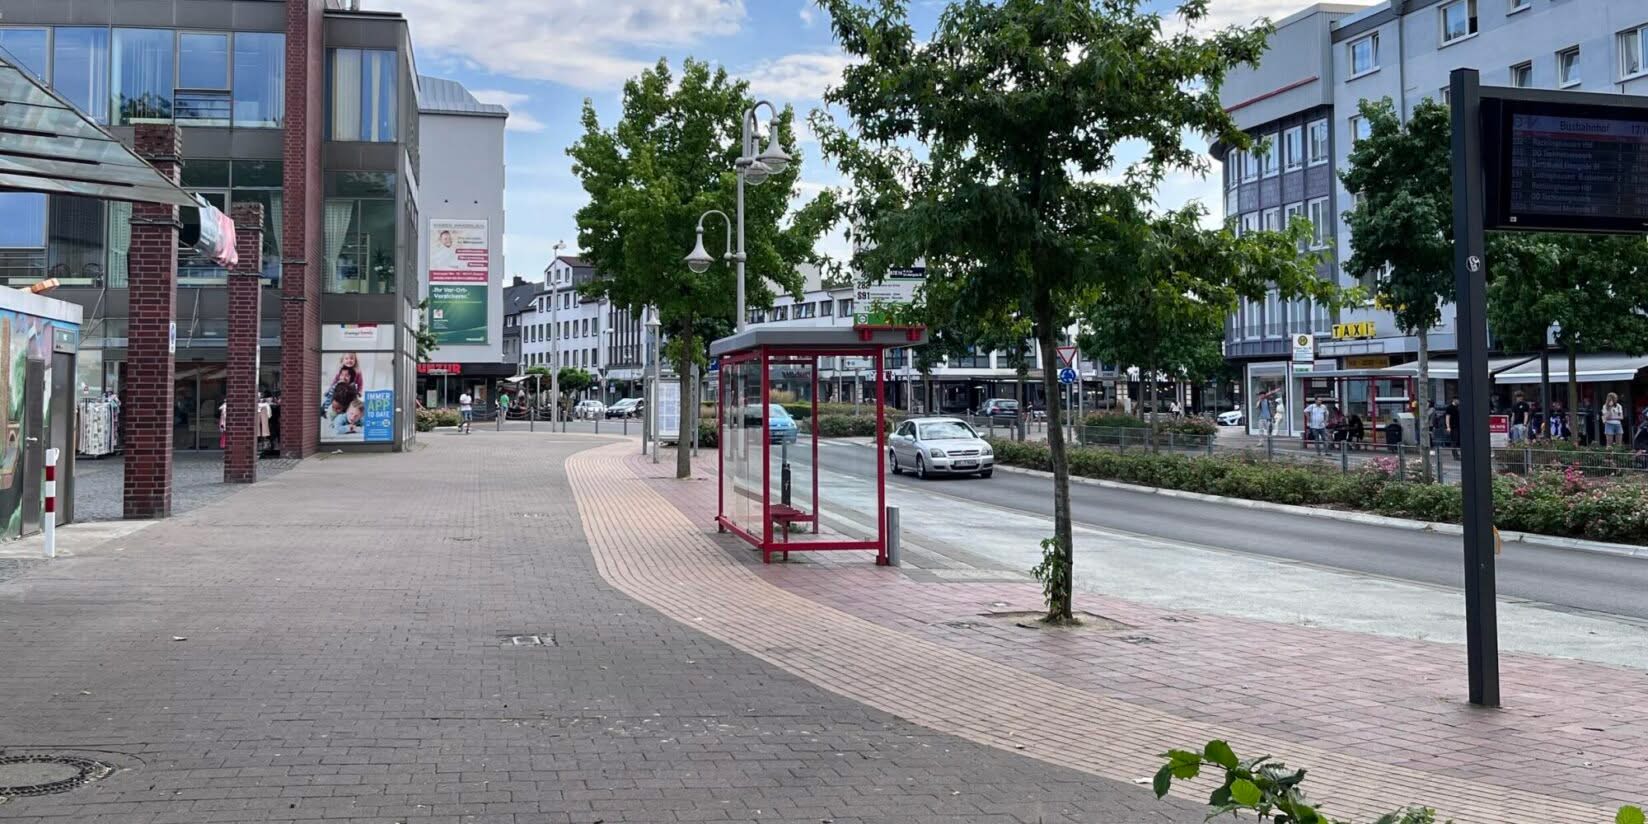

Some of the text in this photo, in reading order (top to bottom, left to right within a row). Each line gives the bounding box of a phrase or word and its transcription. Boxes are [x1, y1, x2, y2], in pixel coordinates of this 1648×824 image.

[857, 292, 870, 300] S91
[1333, 324, 1368, 338] TAXI
[368, 400, 390, 412] APP
